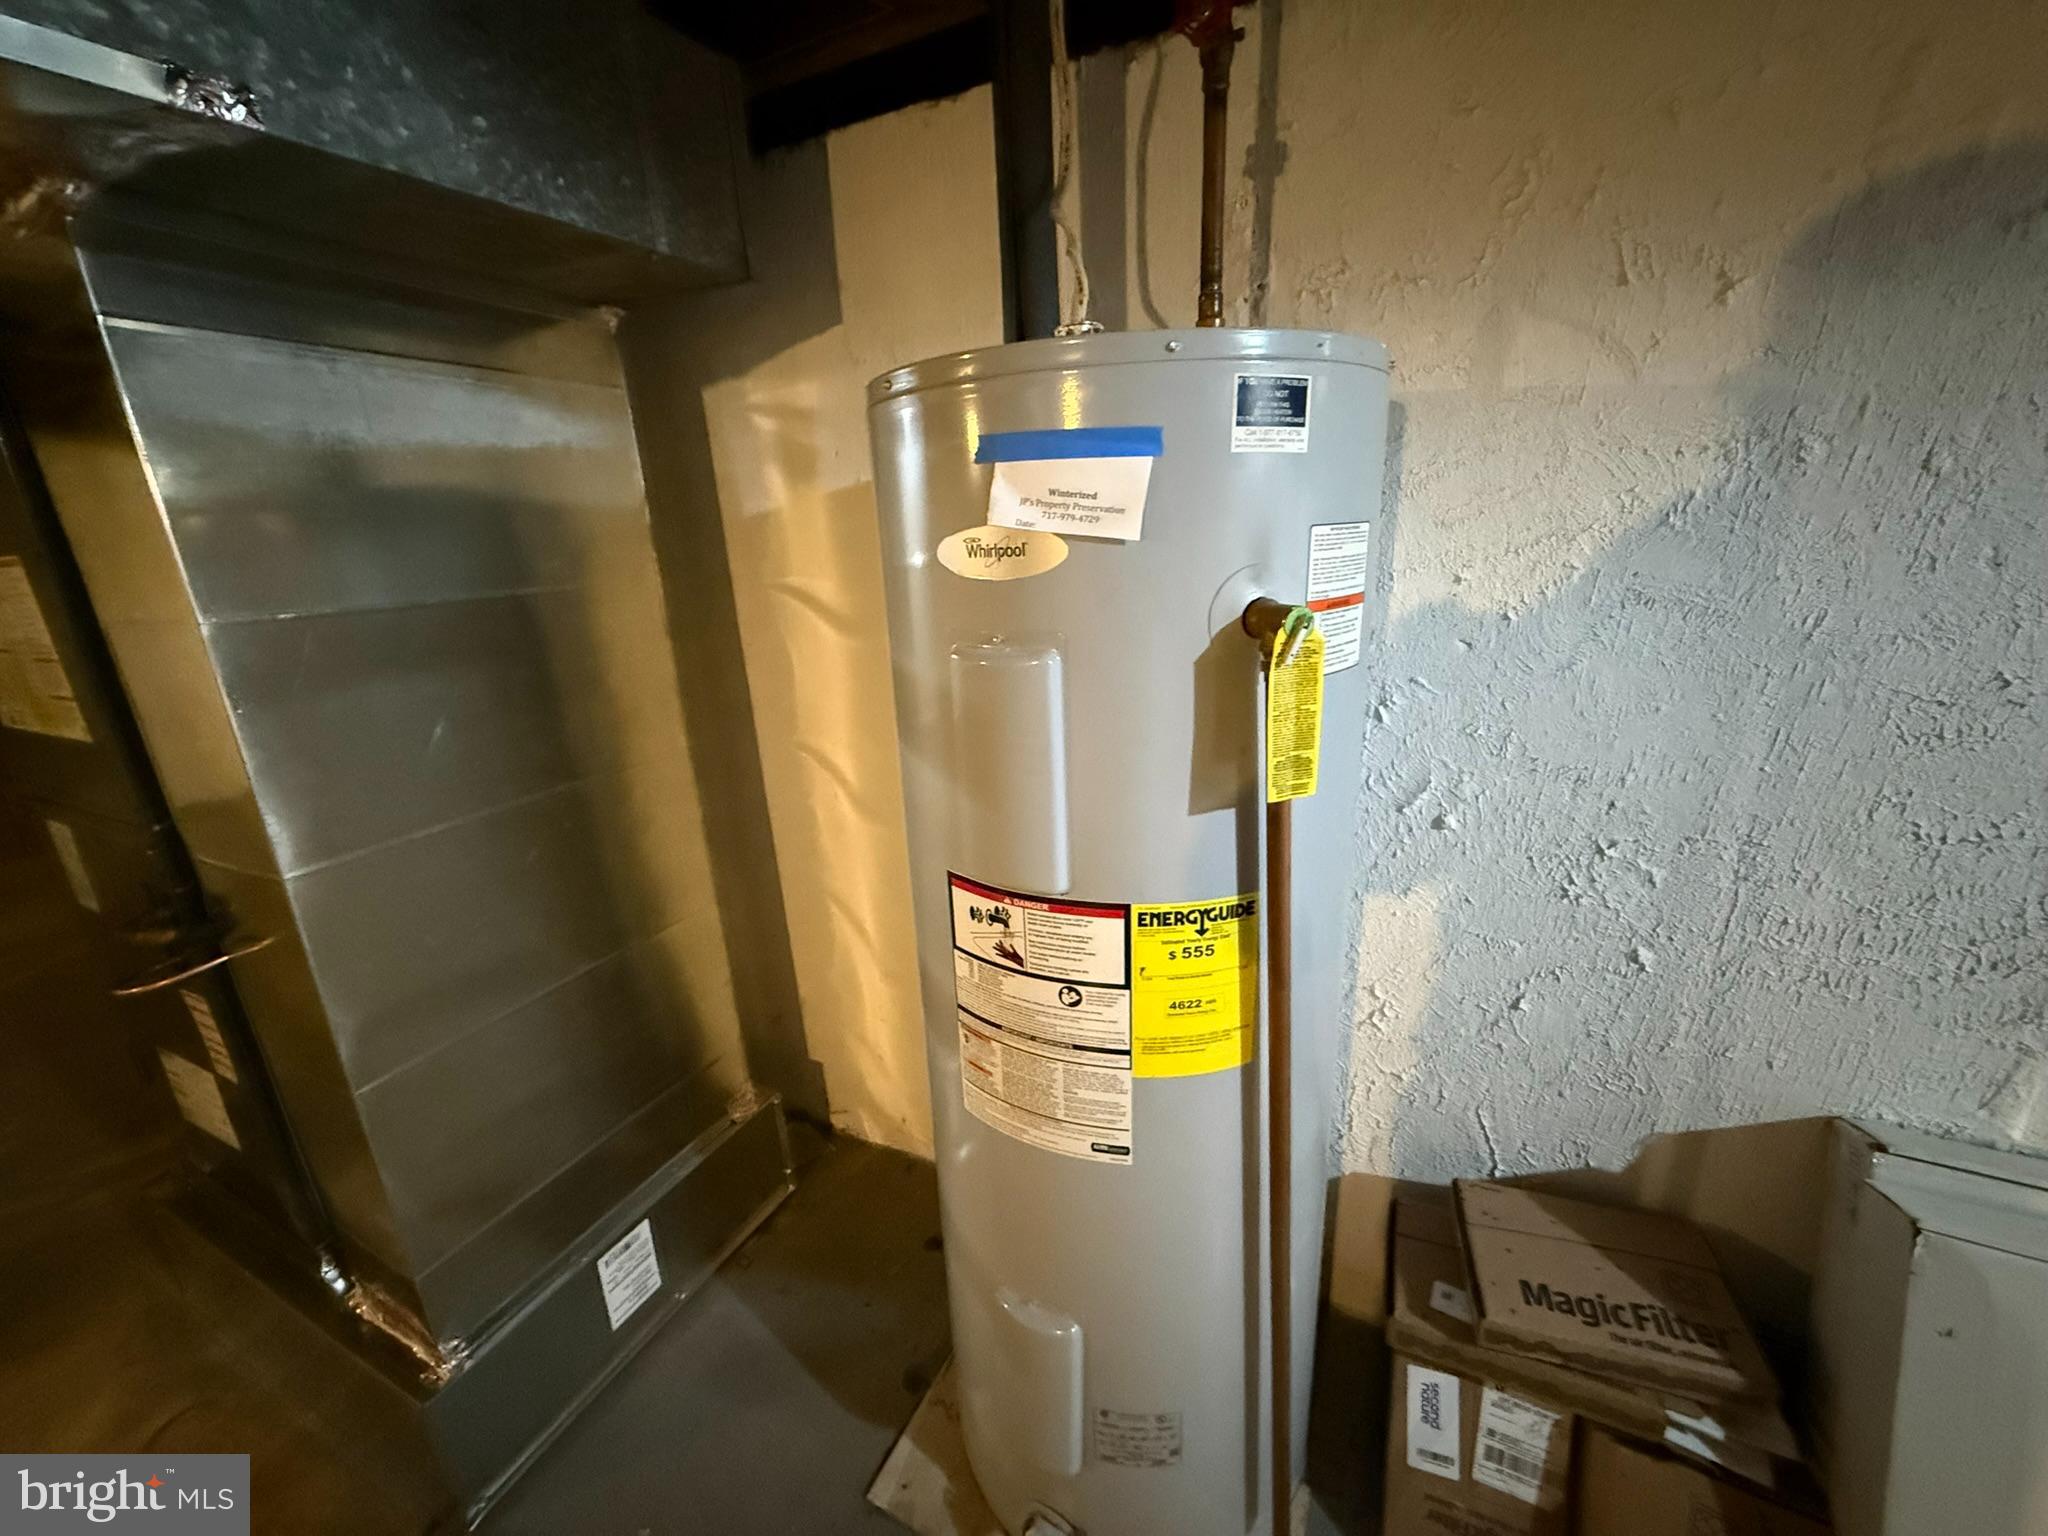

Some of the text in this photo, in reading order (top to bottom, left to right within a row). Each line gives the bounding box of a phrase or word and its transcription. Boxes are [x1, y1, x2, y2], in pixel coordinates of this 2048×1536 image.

[1048, 487, 1098, 500] Winterized
[1036, 499, 1070, 512] Property
[1072, 503, 1126, 515] Preservation
[1041, 510, 1101, 524] 717-979-4729
[966, 542, 1027, 562] Whirlpool
[1013, 898, 1049, 911] DANGER
[1137, 900, 1257, 933] ENERGYGUIDE
[1182, 944, 1215, 959] 555
[1169, 999, 1203, 1010] 4622
[1518, 1279, 1728, 1351] MagicFilter
[1420, 1382, 1430, 1425] nature
[1430, 1382, 1442, 1431] second
